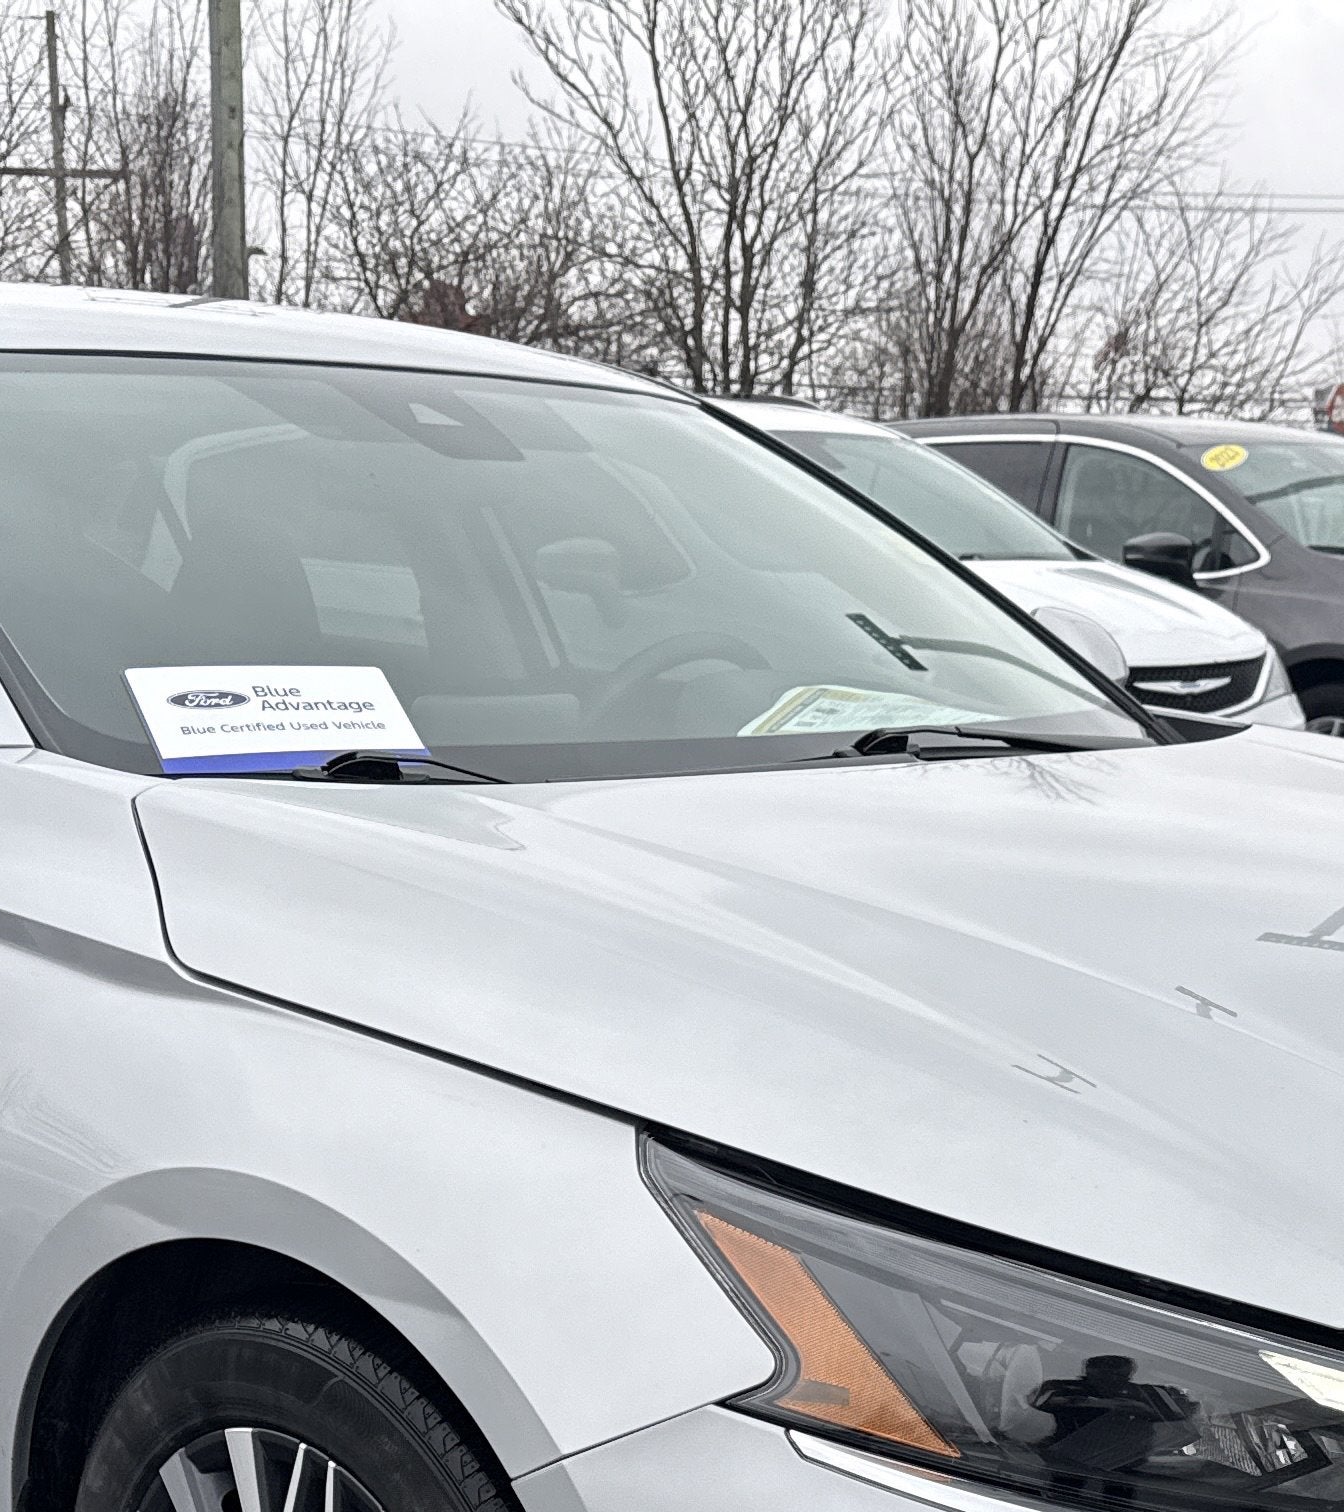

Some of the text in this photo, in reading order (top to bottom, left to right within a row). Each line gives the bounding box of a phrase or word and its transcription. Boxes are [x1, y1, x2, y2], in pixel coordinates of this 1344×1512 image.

[252, 685, 301, 697] Blue
[184, 692, 234, 707] Ford
[262, 699, 375, 713] Advantage
[180, 720, 387, 735] Blue Certified Used Vehicle
